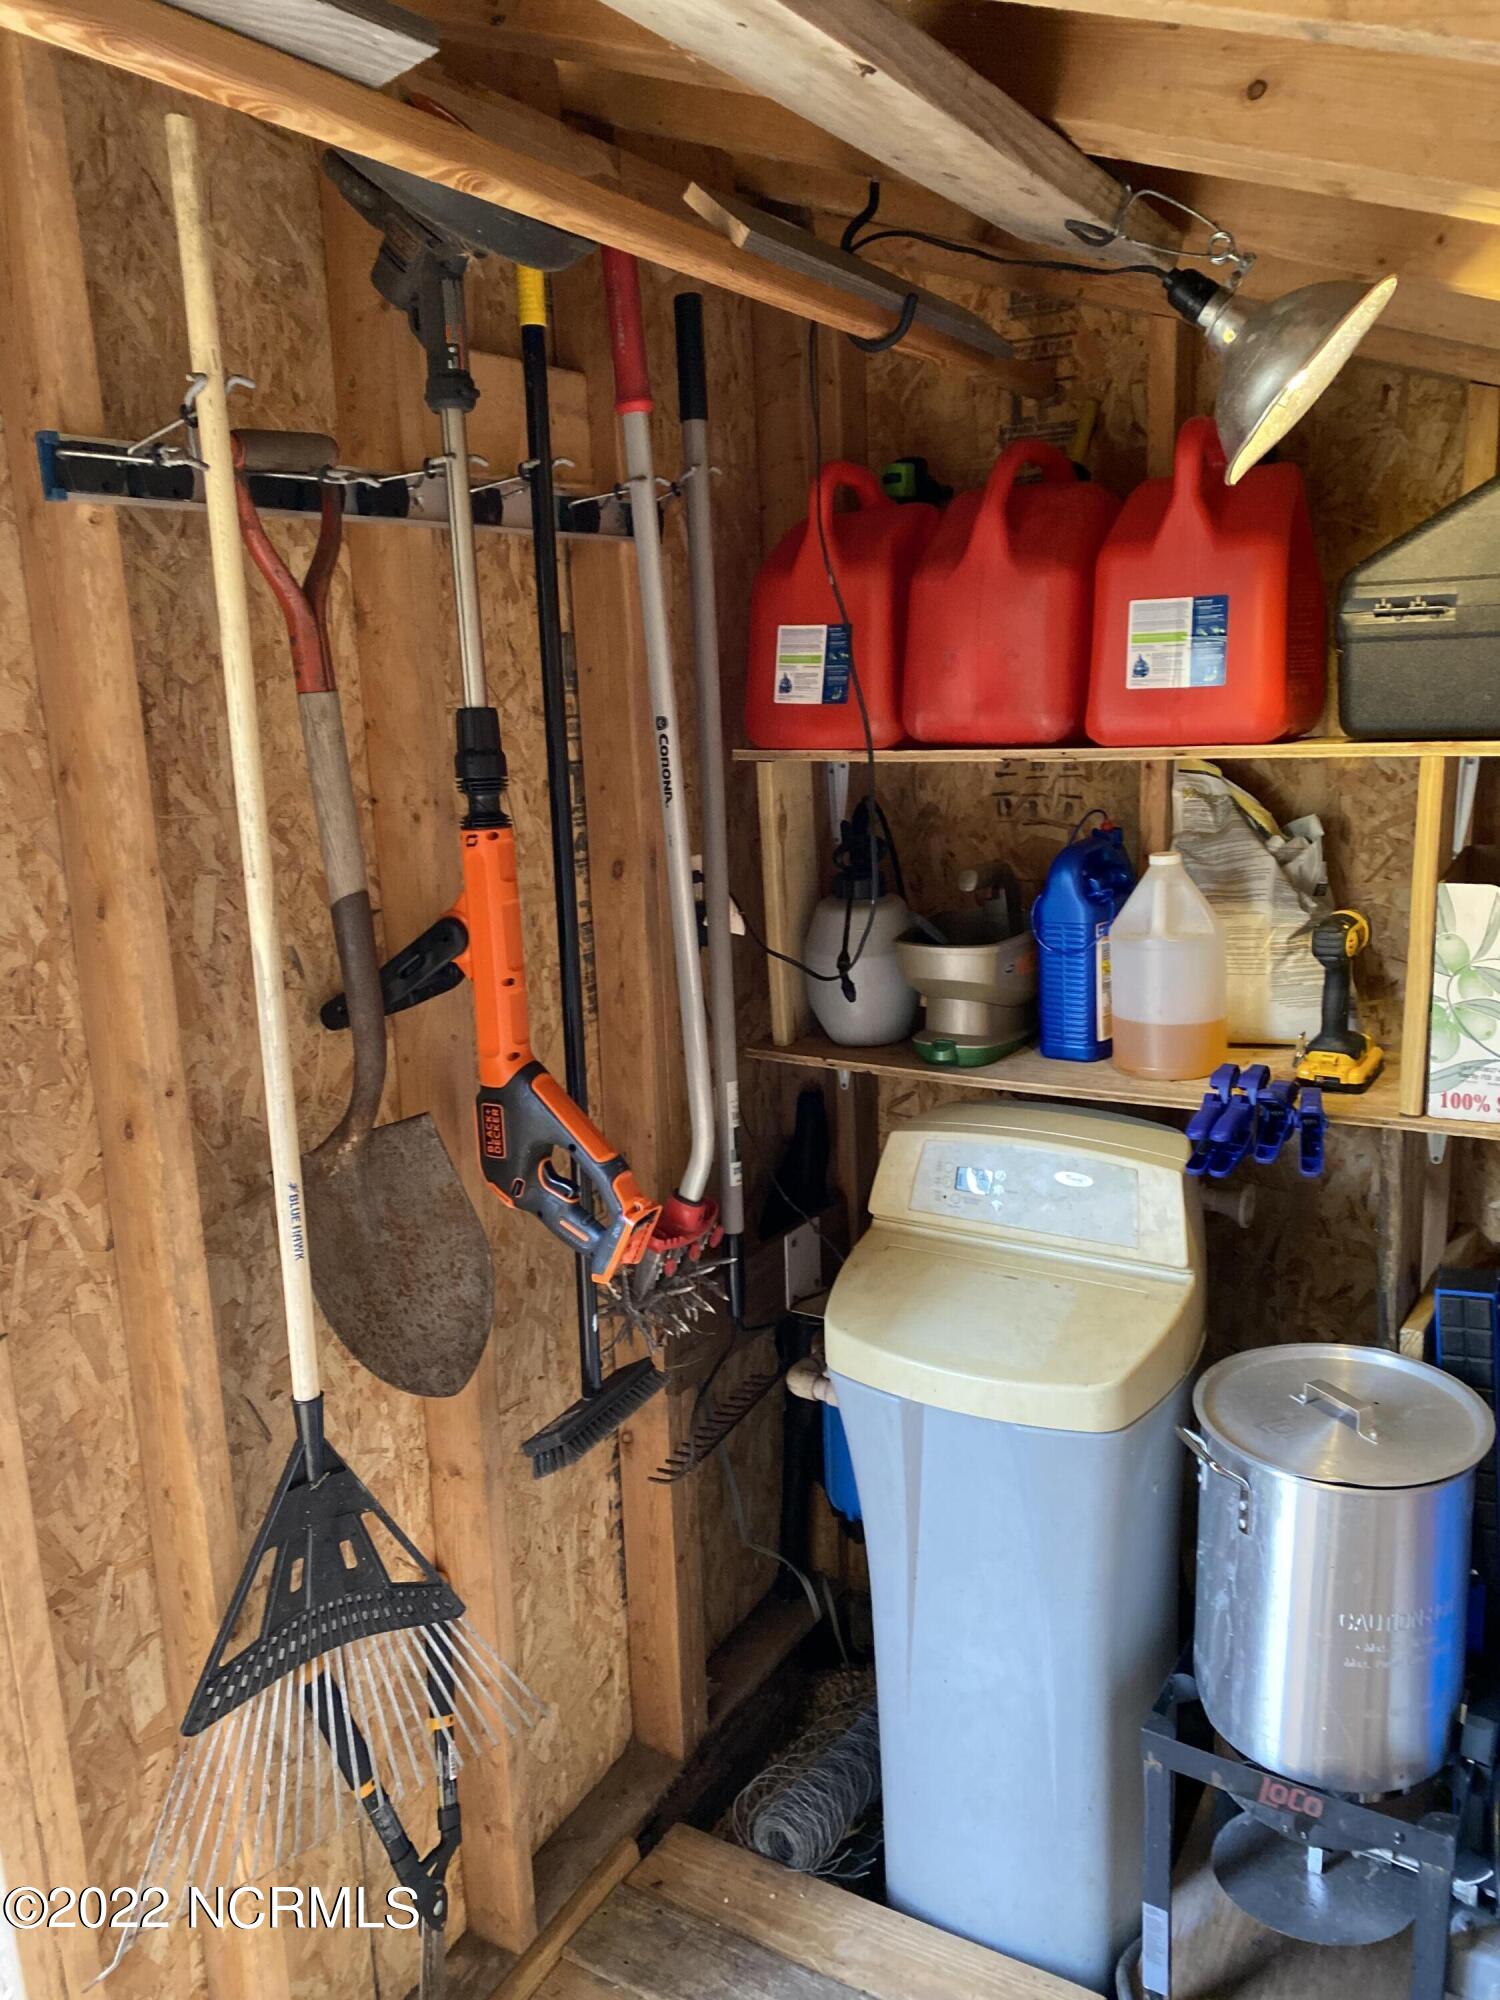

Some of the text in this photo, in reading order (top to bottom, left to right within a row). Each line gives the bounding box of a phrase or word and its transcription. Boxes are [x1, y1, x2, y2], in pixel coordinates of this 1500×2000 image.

[658, 733, 673, 805] CORONA
[1440, 1088, 1491, 1113] 100%
[288, 1193, 304, 1261] BLUE HAWK
